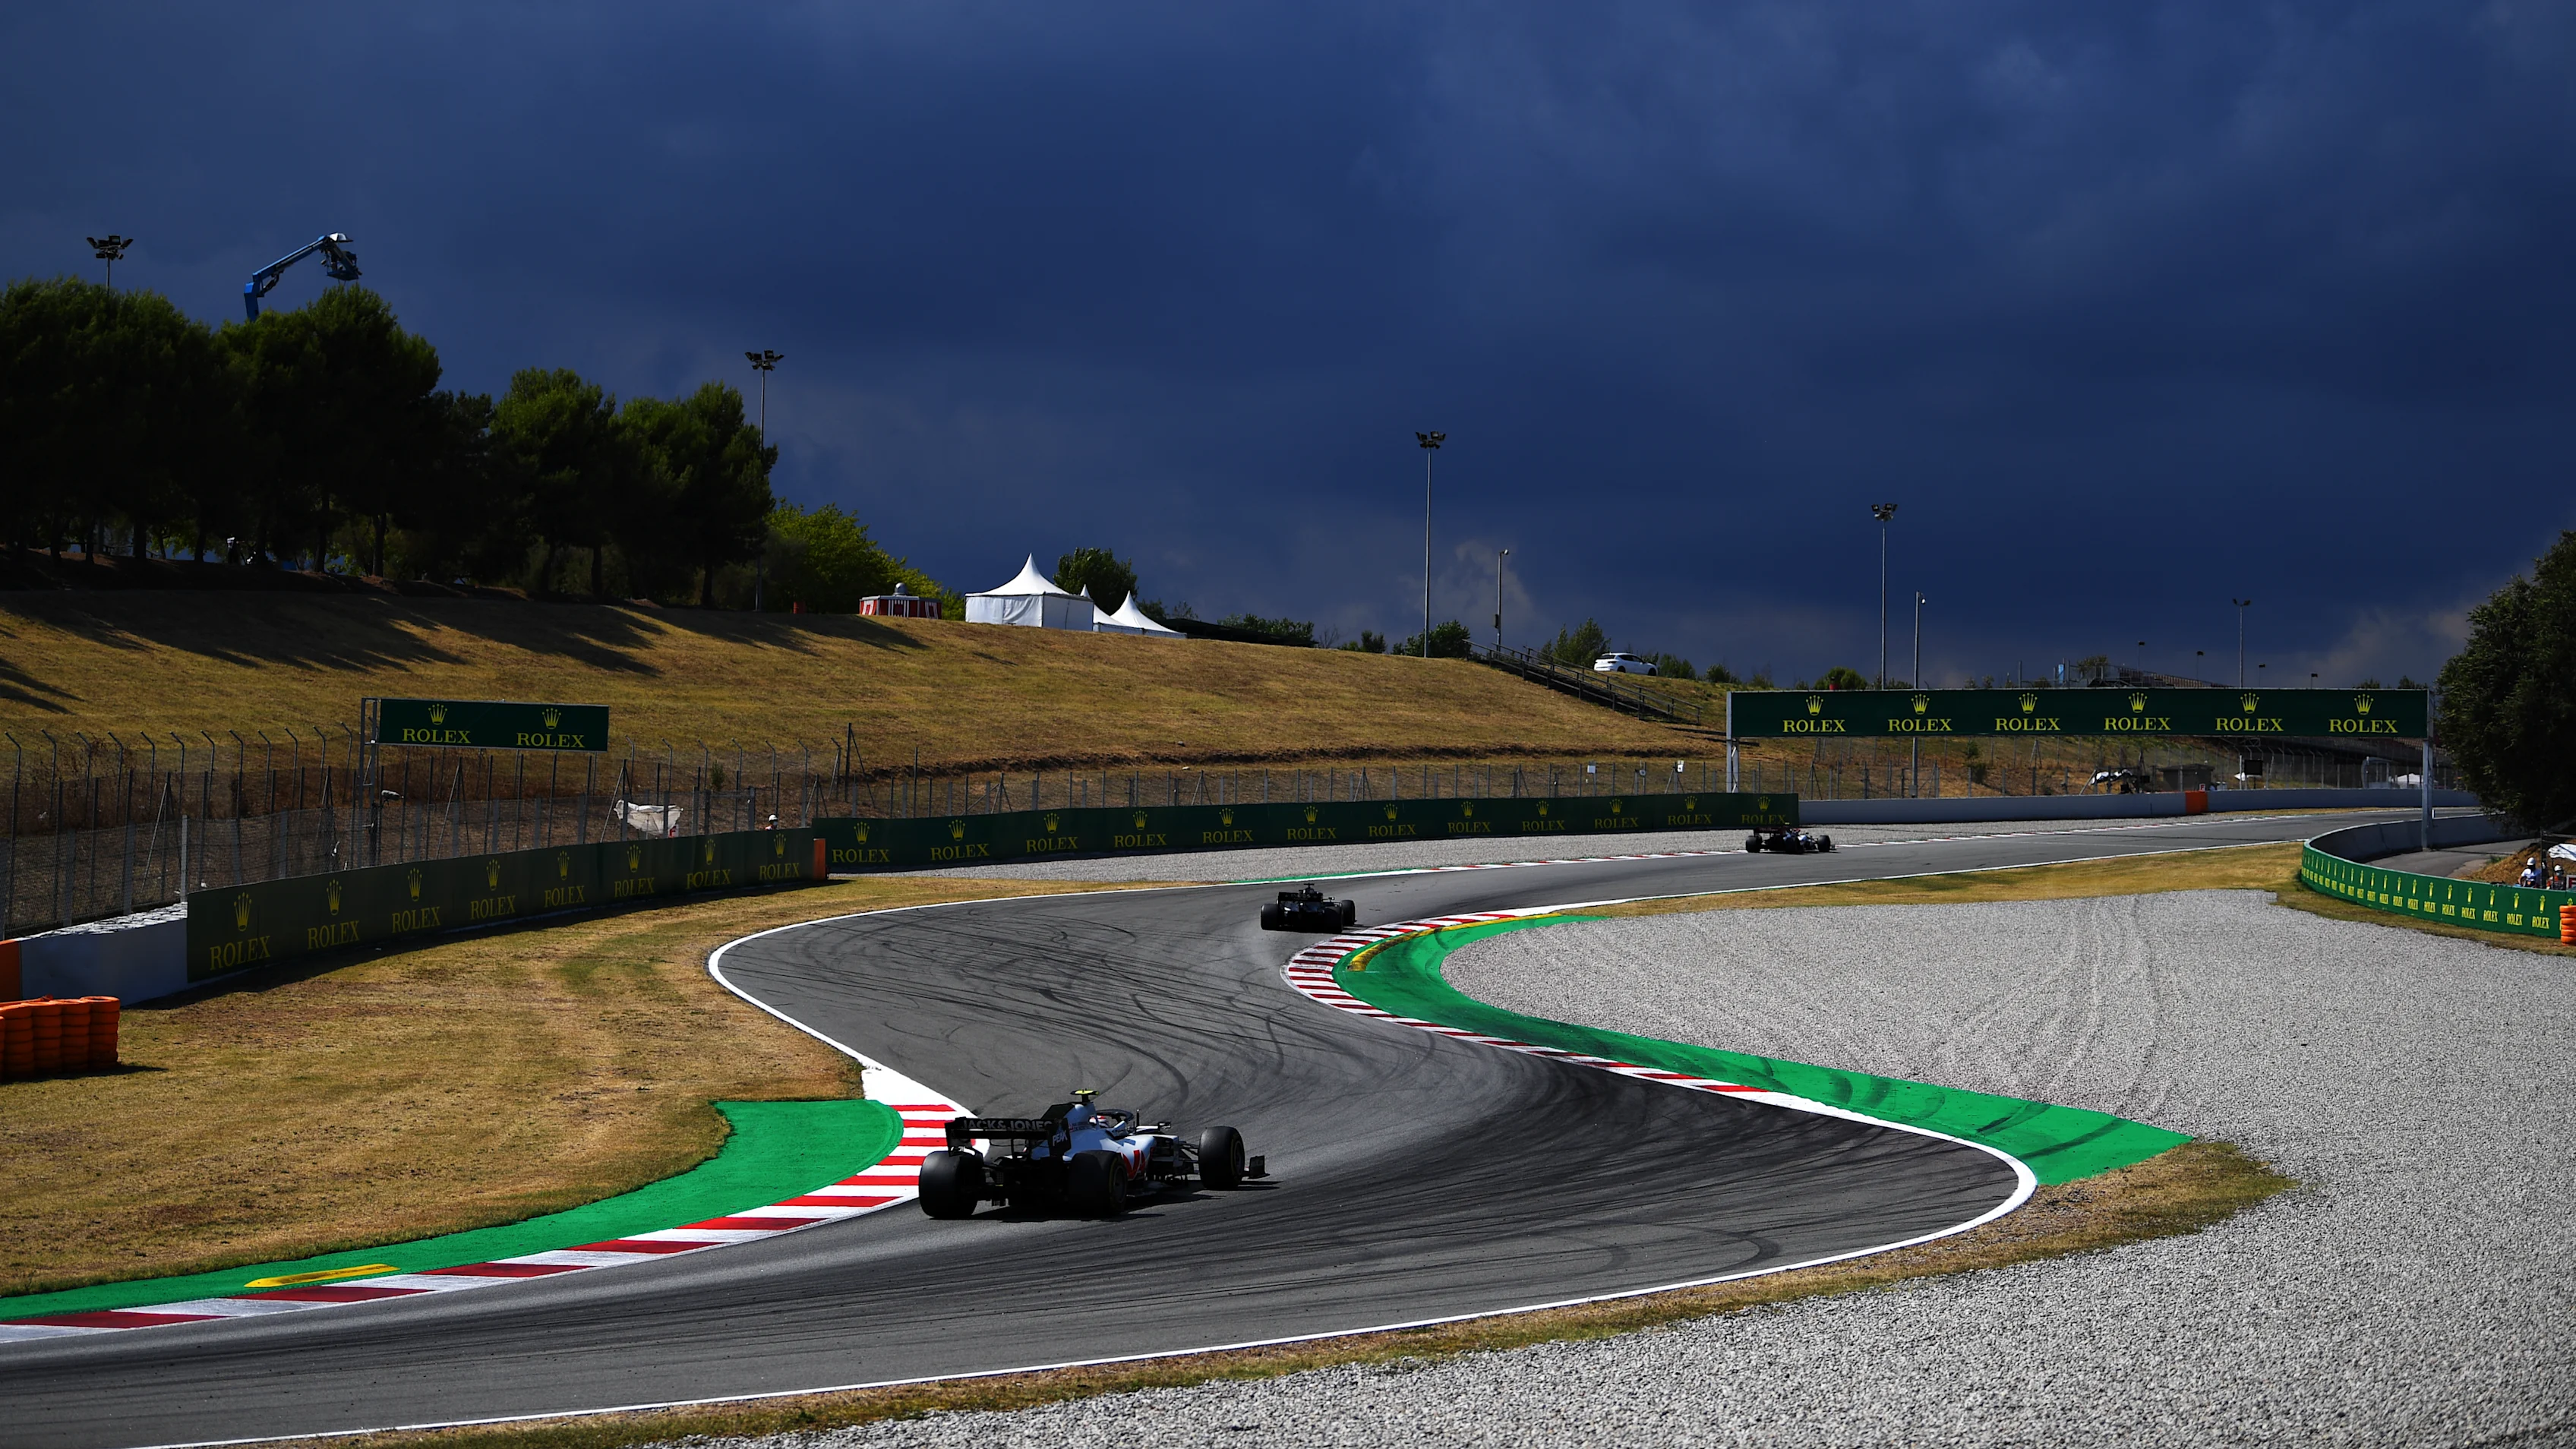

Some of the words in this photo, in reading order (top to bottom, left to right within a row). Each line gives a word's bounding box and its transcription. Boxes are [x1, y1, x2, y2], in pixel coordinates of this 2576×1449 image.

[1782, 719, 1846, 733] ROLEX
[1888, 718, 1953, 732] ROLEX
[1995, 718, 2061, 731] ROLEX
[2104, 717, 2171, 731] ROLEX
[2215, 718, 2284, 731] ROLEX
[2328, 719, 2398, 733] ROLEX
[402, 728, 471, 744] ROLEX
[516, 732, 585, 748] ROLEX
[832, 848, 890, 863] ROLEX
[930, 843, 990, 861] ROLEX
[1025, 837, 1078, 853] ROLEX
[1113, 834, 1167, 848] ROLEX
[1202, 829, 1254, 844] ROLEX
[1286, 826, 1337, 841] ROLEX
[1368, 824, 1416, 836] ROLEX
[1447, 821, 1492, 833] ROLEX
[1522, 819, 1565, 832] ROLEX
[1594, 817, 1639, 829] ROLEX
[1668, 814, 1713, 826] ROLEX
[1741, 814, 1787, 825] ROLEX
[210, 935, 271, 971] ROLEX
[307, 920, 360, 950] ROLEX
[392, 906, 440, 933] ROLEX
[470, 895, 516, 920] ROLEX
[544, 885, 585, 908] ROLEX
[614, 876, 655, 898] ROLEX
[686, 869, 731, 889] ROLEX
[759, 862, 800, 881] ROLEX
[2442, 904, 2455, 916] ROLEX
[2461, 907, 2476, 920] ROLEX
[2483, 910, 2499, 923] ROLEX
[2506, 913, 2524, 926] ROLEX
[2531, 916, 2550, 930] ROLEX
[1053, 1130, 1068, 1147] PEAK
